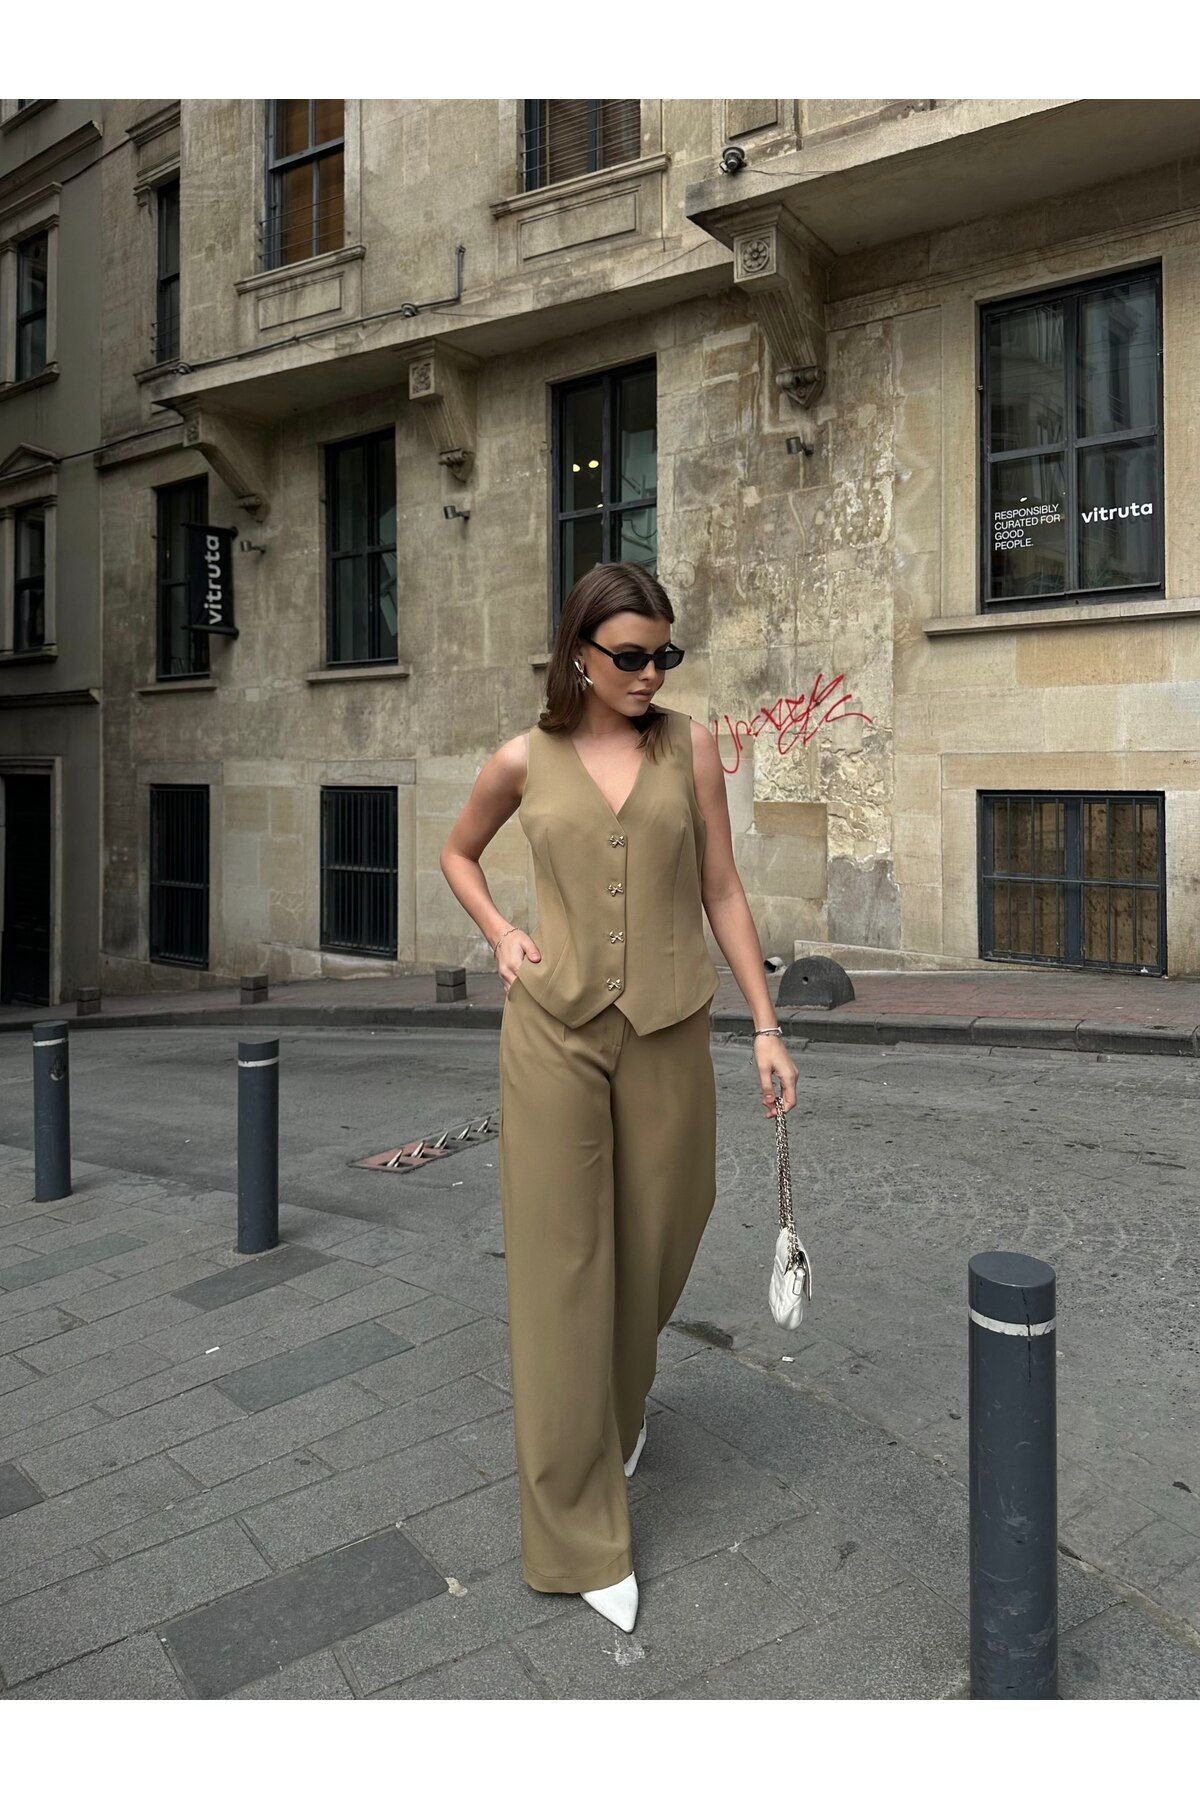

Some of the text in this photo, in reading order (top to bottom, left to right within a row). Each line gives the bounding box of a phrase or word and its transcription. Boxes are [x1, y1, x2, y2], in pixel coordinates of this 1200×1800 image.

[995, 504, 1059, 521] RESPONSIBLY
[1081, 502, 1153, 524] vitruta
[995, 514, 1061, 531] CURATED FOR
[995, 529, 1024, 541] GOOD
[995, 538, 1034, 551] PEOPLE.
[204, 535, 222, 625] vitruta
